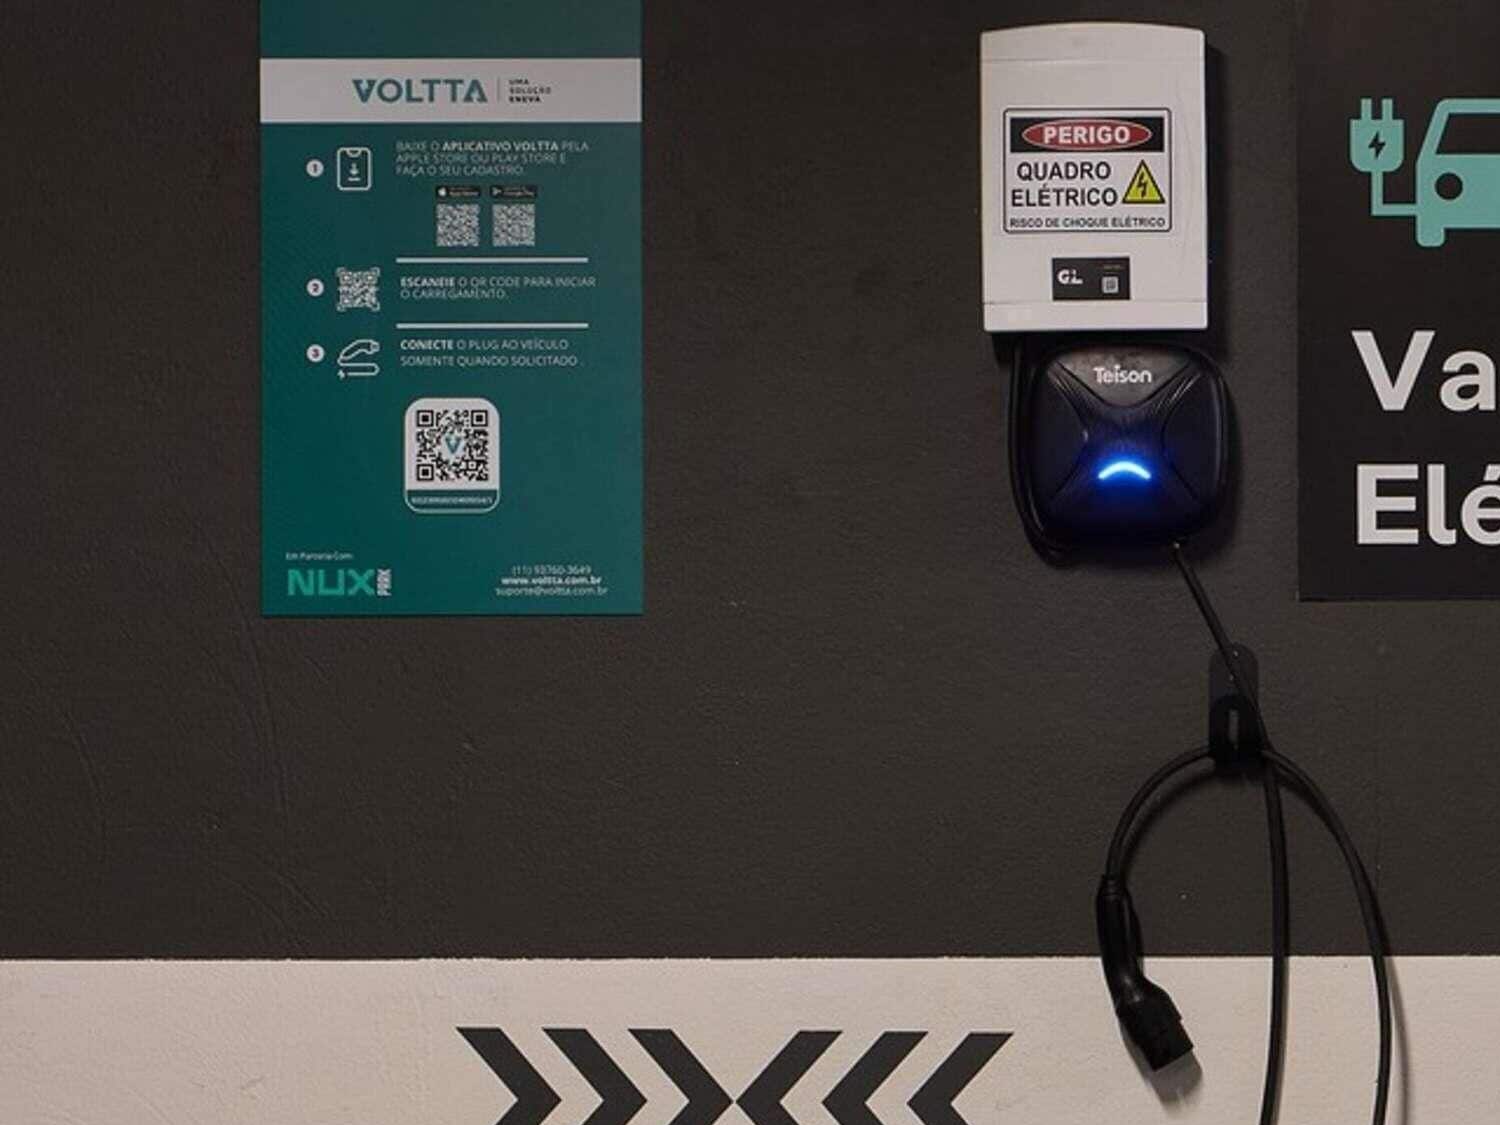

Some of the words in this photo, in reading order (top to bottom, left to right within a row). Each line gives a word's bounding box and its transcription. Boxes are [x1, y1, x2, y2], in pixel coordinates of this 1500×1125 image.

[352, 79, 488, 103] VOLTTA
[1044, 125, 1131, 145] PERIGO
[430, 141, 440, 151] O
[442, 141, 511, 151] APLICATIVO
[513, 141, 559, 151] VOLTTA
[561, 141, 589, 151] PELA
[396, 153, 429, 163] APPLE
[470, 153, 490, 163] OU
[396, 166, 425, 177] FAÇA
[427, 166, 437, 175] O
[439, 166, 461, 175] SEU
[1016, 161, 1111, 182] QUADRO
[1011, 184, 1118, 207] ELÉTRICO
[1009, 217, 1043, 228] RISCO
[1045, 217, 1059, 228] DE
[1062, 217, 1109, 228] CHOQUE
[1112, 216, 1166, 228] ELÉTRICO
[400, 276, 455, 287] ESCANEIE
[458, 276, 468, 287] O
[470, 276, 487, 288] QR
[489, 276, 521, 287] CODE
[523, 276, 552, 287] PARA
[554, 276, 597, 287] INICIAR
[400, 288, 410, 299] O
[400, 339, 454, 350] CONECTE
[456, 339, 467, 350] O
[469, 339, 499, 350] PLUG
[501, 339, 518, 350] AO
[520, 338, 569, 350] VEÍCULO
[400, 356, 454, 366] SOMENTE
[456, 356, 509, 368] QUANDO
[1093, 364, 1152, 384] Teison
[287, 568, 376, 597] NUX
